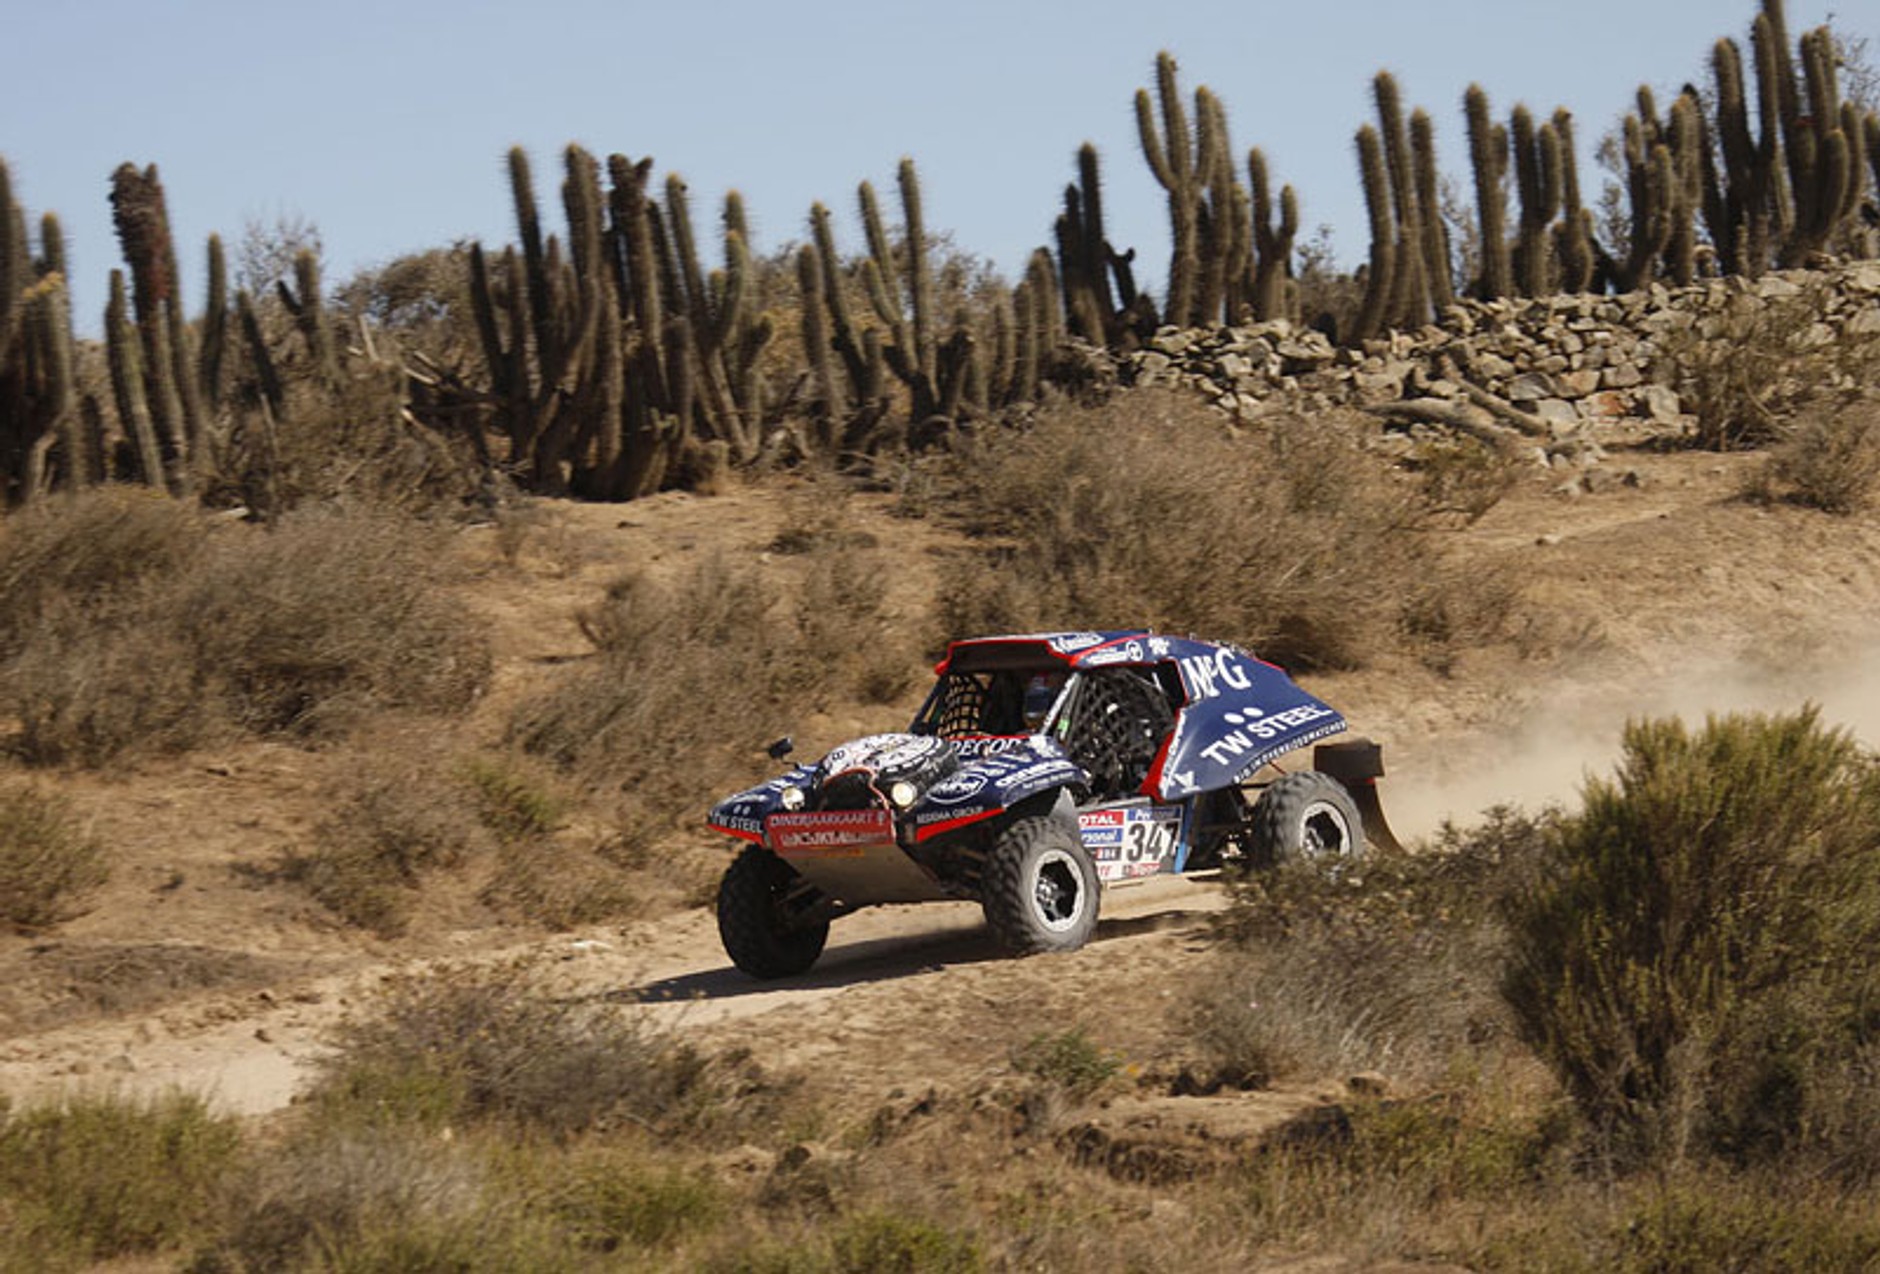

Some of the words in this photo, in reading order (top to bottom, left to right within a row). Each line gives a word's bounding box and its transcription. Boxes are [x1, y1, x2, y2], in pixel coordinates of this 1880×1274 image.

[1199, 729, 1254, 765] TW
[1246, 704, 1334, 739] STEEL
[729, 816, 764, 834] STEEL
[1079, 815, 1117, 826] OTAL
[1127, 822, 1178, 863] 347
